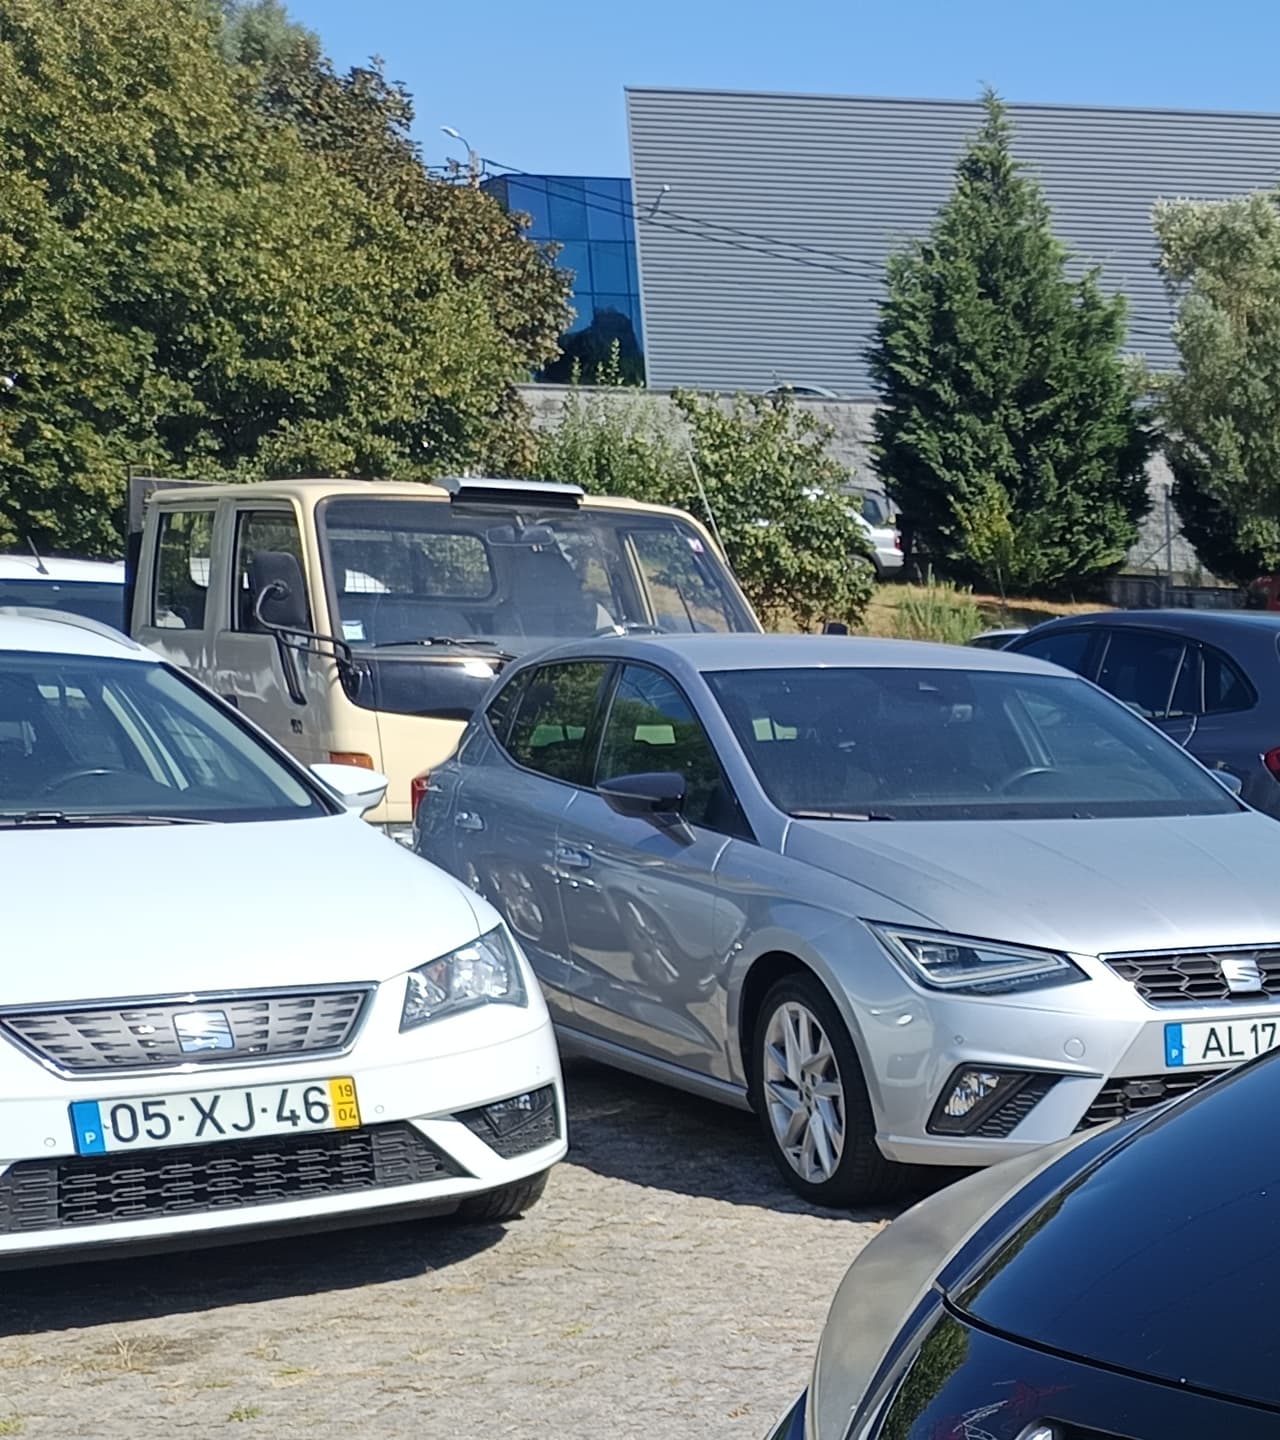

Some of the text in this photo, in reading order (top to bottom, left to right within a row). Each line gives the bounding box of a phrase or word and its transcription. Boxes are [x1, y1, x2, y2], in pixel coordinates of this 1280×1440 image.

[1202, 1026, 1245, 1060] AL
[338, 1078, 353, 1098] 19
[338, 1107, 357, 1122] 04
[84, 1132, 97, 1145] P
